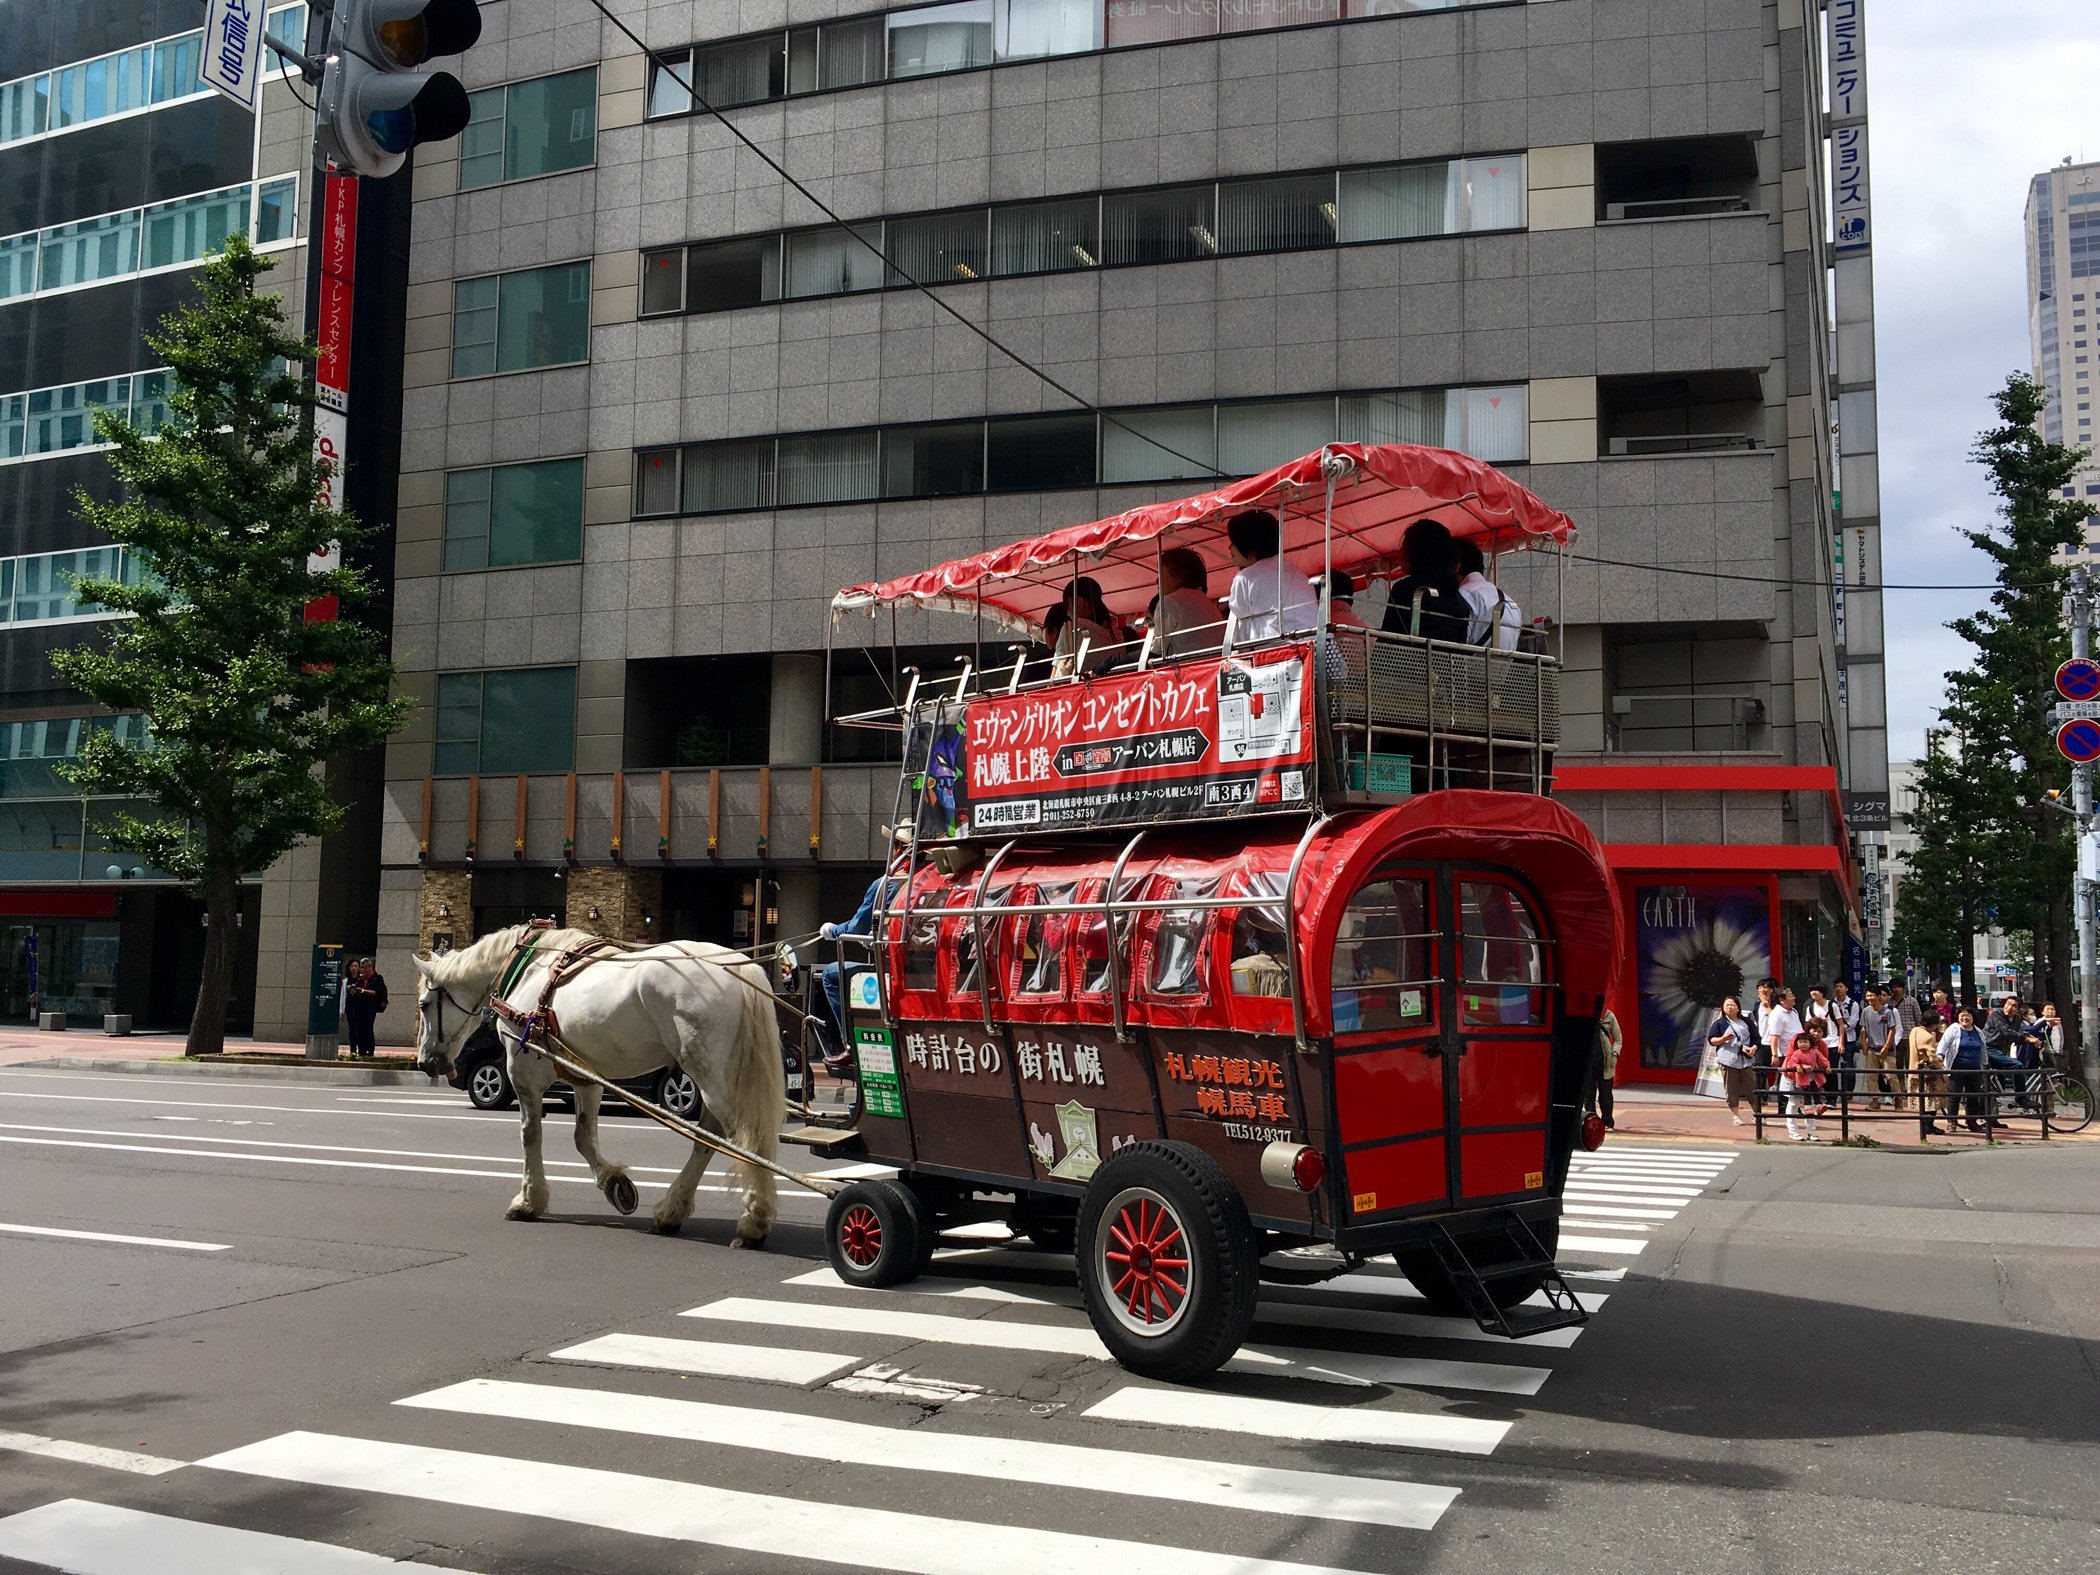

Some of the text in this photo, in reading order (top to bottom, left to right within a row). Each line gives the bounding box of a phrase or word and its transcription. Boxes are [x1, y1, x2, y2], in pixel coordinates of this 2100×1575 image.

[973, 680, 1210, 749] エヴァンゲリオン コンセプトカフェ
[973, 747, 1050, 788] 札幌上陸
[1209, 784, 1251, 803] 南3西4
[1854, 802, 1886, 811] シグマ
[979, 803, 1037, 823] 24時間営業
[1643, 896, 1696, 928] EARTH
[906, 1033, 1000, 1074] 時計台の
[1017, 1041, 1105, 1085] 街札幌
[1165, 1052, 1284, 1088] 札幌観光
[1197, 1086, 1289, 1121] 幌馬車
